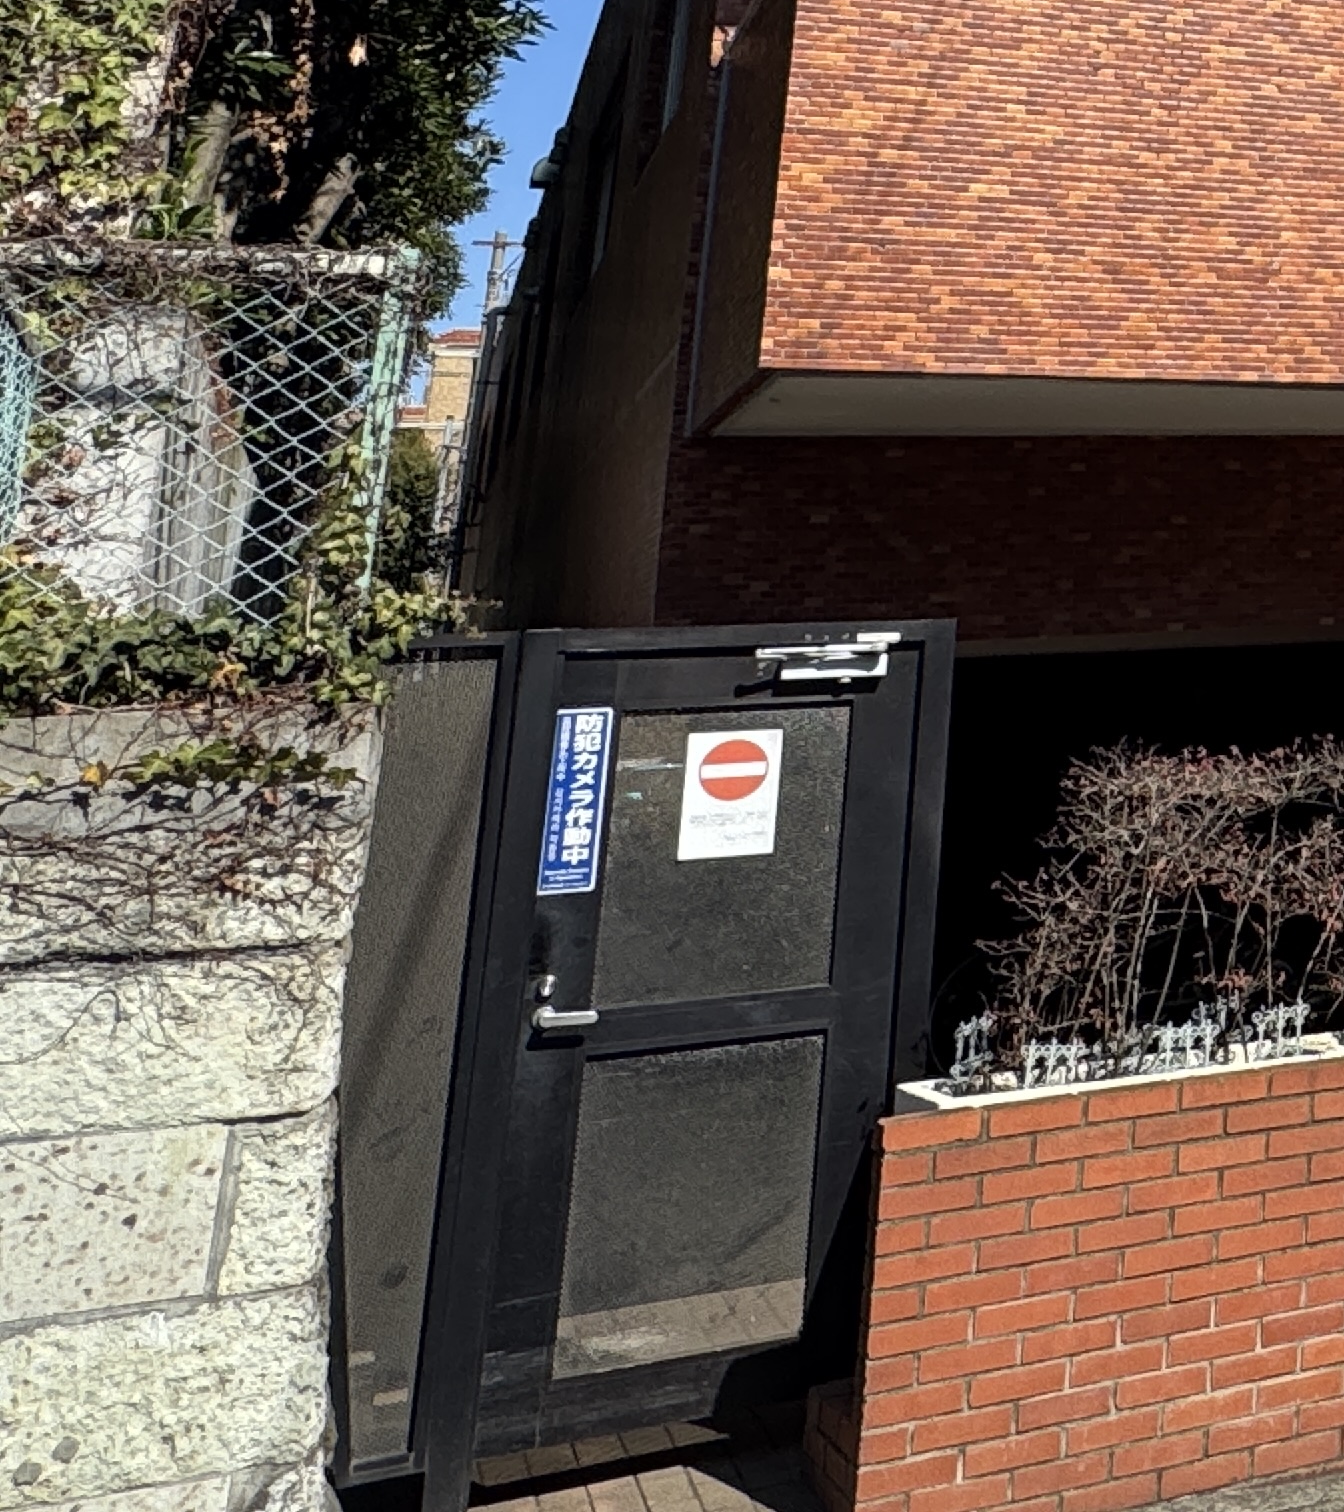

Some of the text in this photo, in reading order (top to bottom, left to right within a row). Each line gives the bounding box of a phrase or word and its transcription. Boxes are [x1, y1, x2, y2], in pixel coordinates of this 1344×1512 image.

[561, 713, 605, 866] 防犯カメラ作動中
